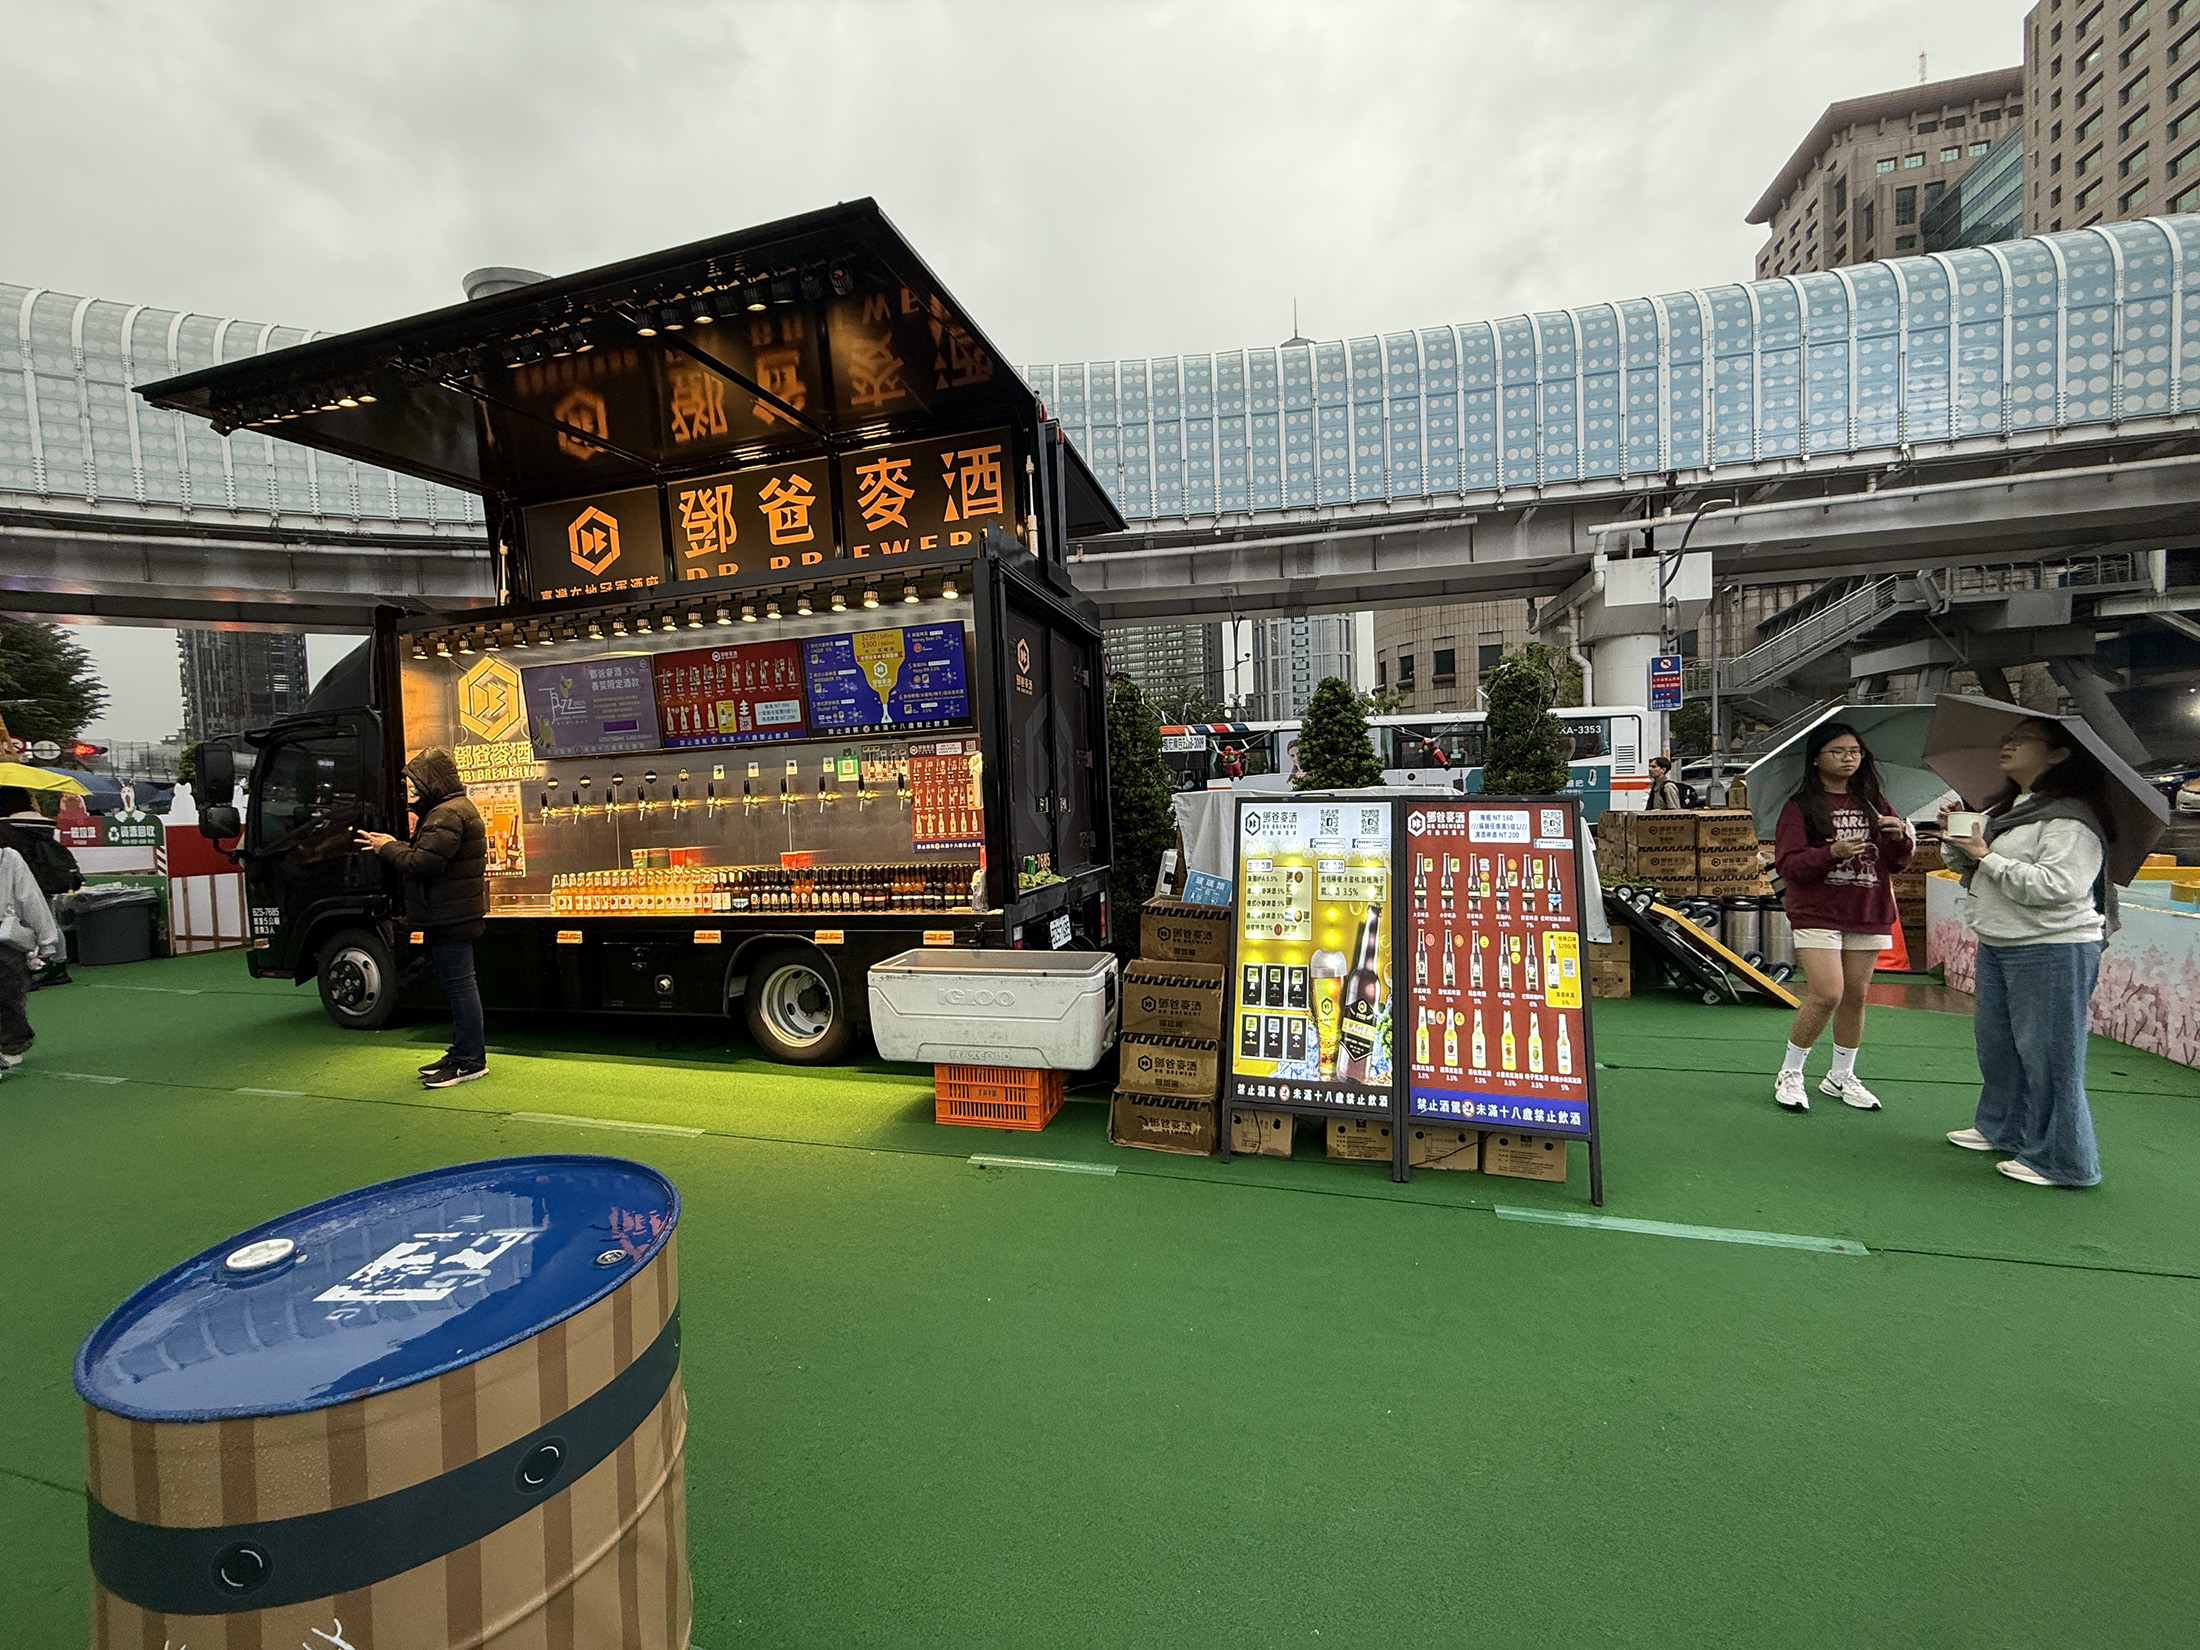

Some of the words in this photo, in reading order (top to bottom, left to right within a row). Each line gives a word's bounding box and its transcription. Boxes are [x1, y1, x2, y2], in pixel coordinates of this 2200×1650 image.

[679, 445, 1003, 558] 鄧爸麥酒
[252, 907, 280, 916] BZS-7685
[1346, 1021, 1373, 1037] LAGER
[1237, 1083, 1276, 1098] 禁止酒駕
[1293, 1088, 1388, 1108] 未滿十八歲禁止飲酒
[1417, 1098, 1461, 1115] 禁止酒駕
[1476, 1103, 1581, 1126] 未滿十八歲禁止飲酒
